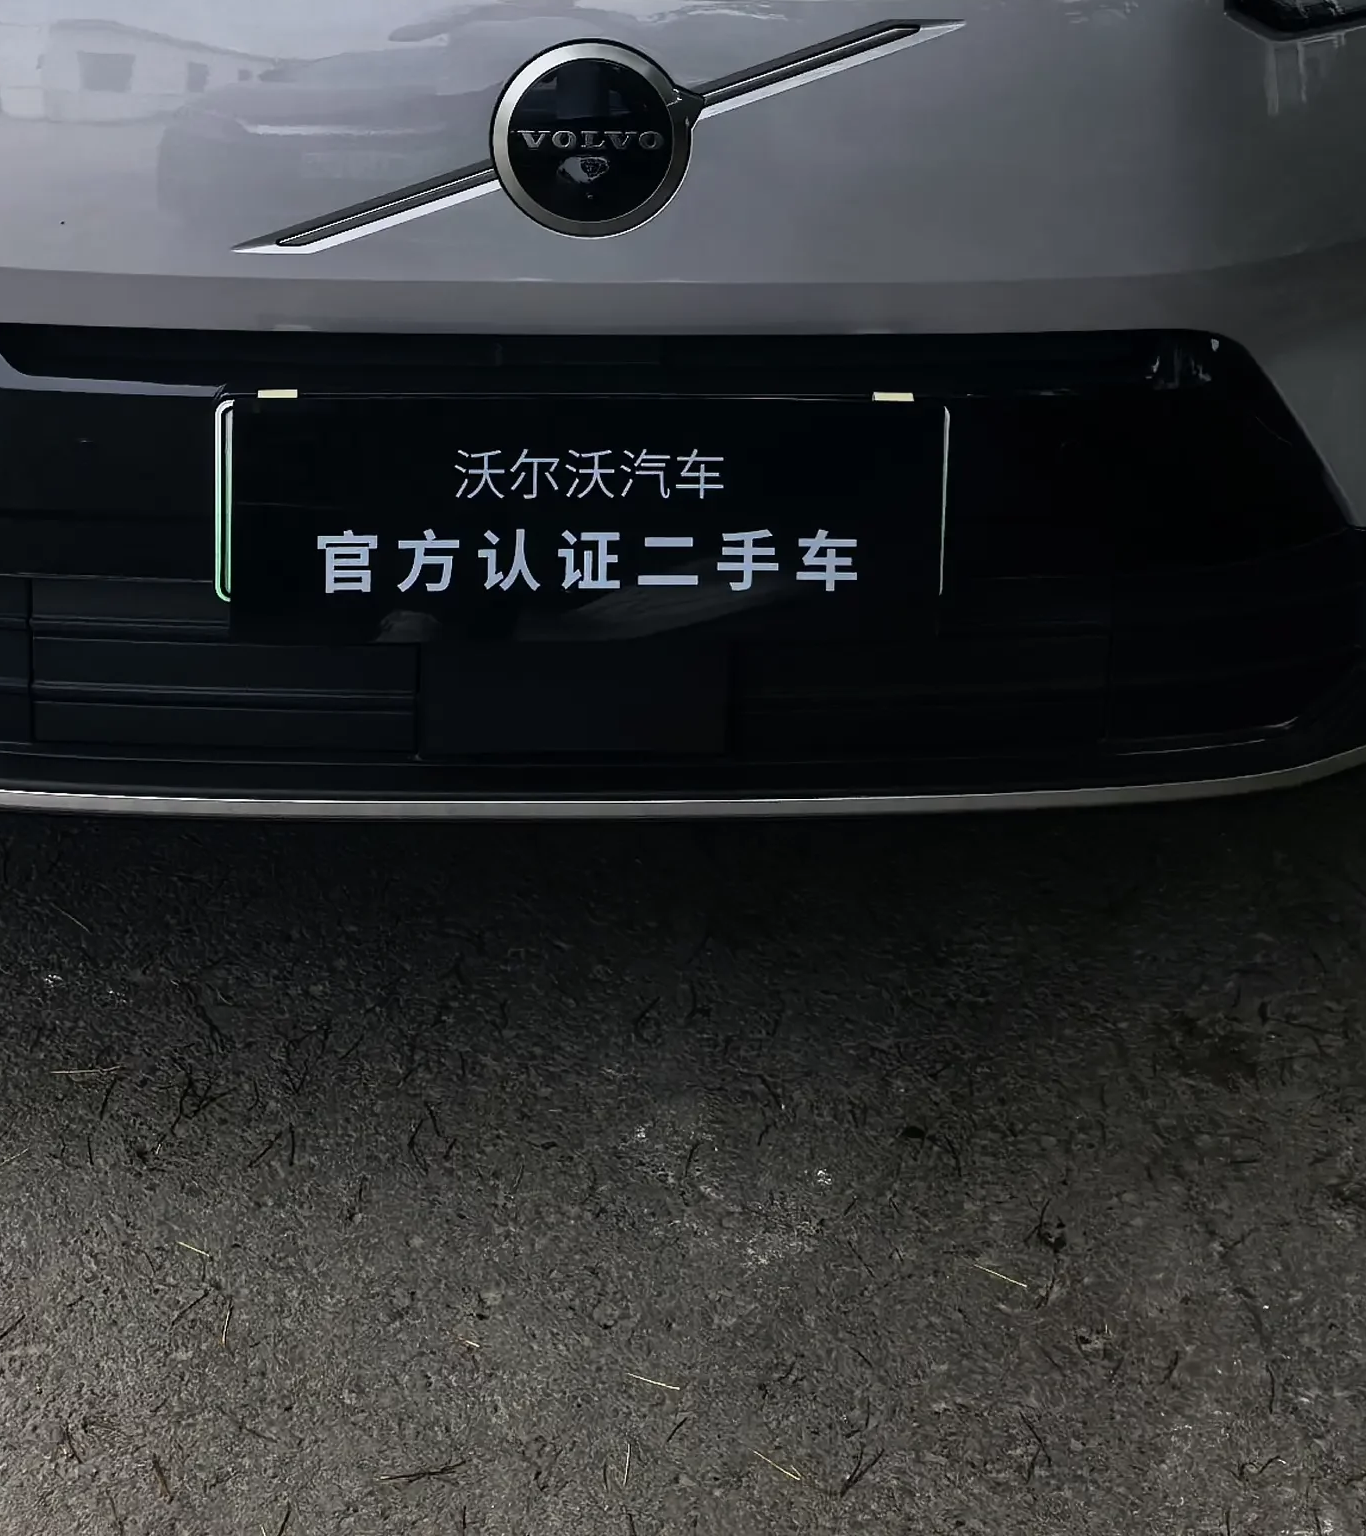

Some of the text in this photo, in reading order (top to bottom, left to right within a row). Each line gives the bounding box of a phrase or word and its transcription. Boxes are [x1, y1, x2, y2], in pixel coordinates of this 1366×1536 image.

[516, 130, 664, 150] VOLVO
[454, 448, 725, 500] 沃尔沃汽车
[316, 528, 858, 594] 官方认证二手车
